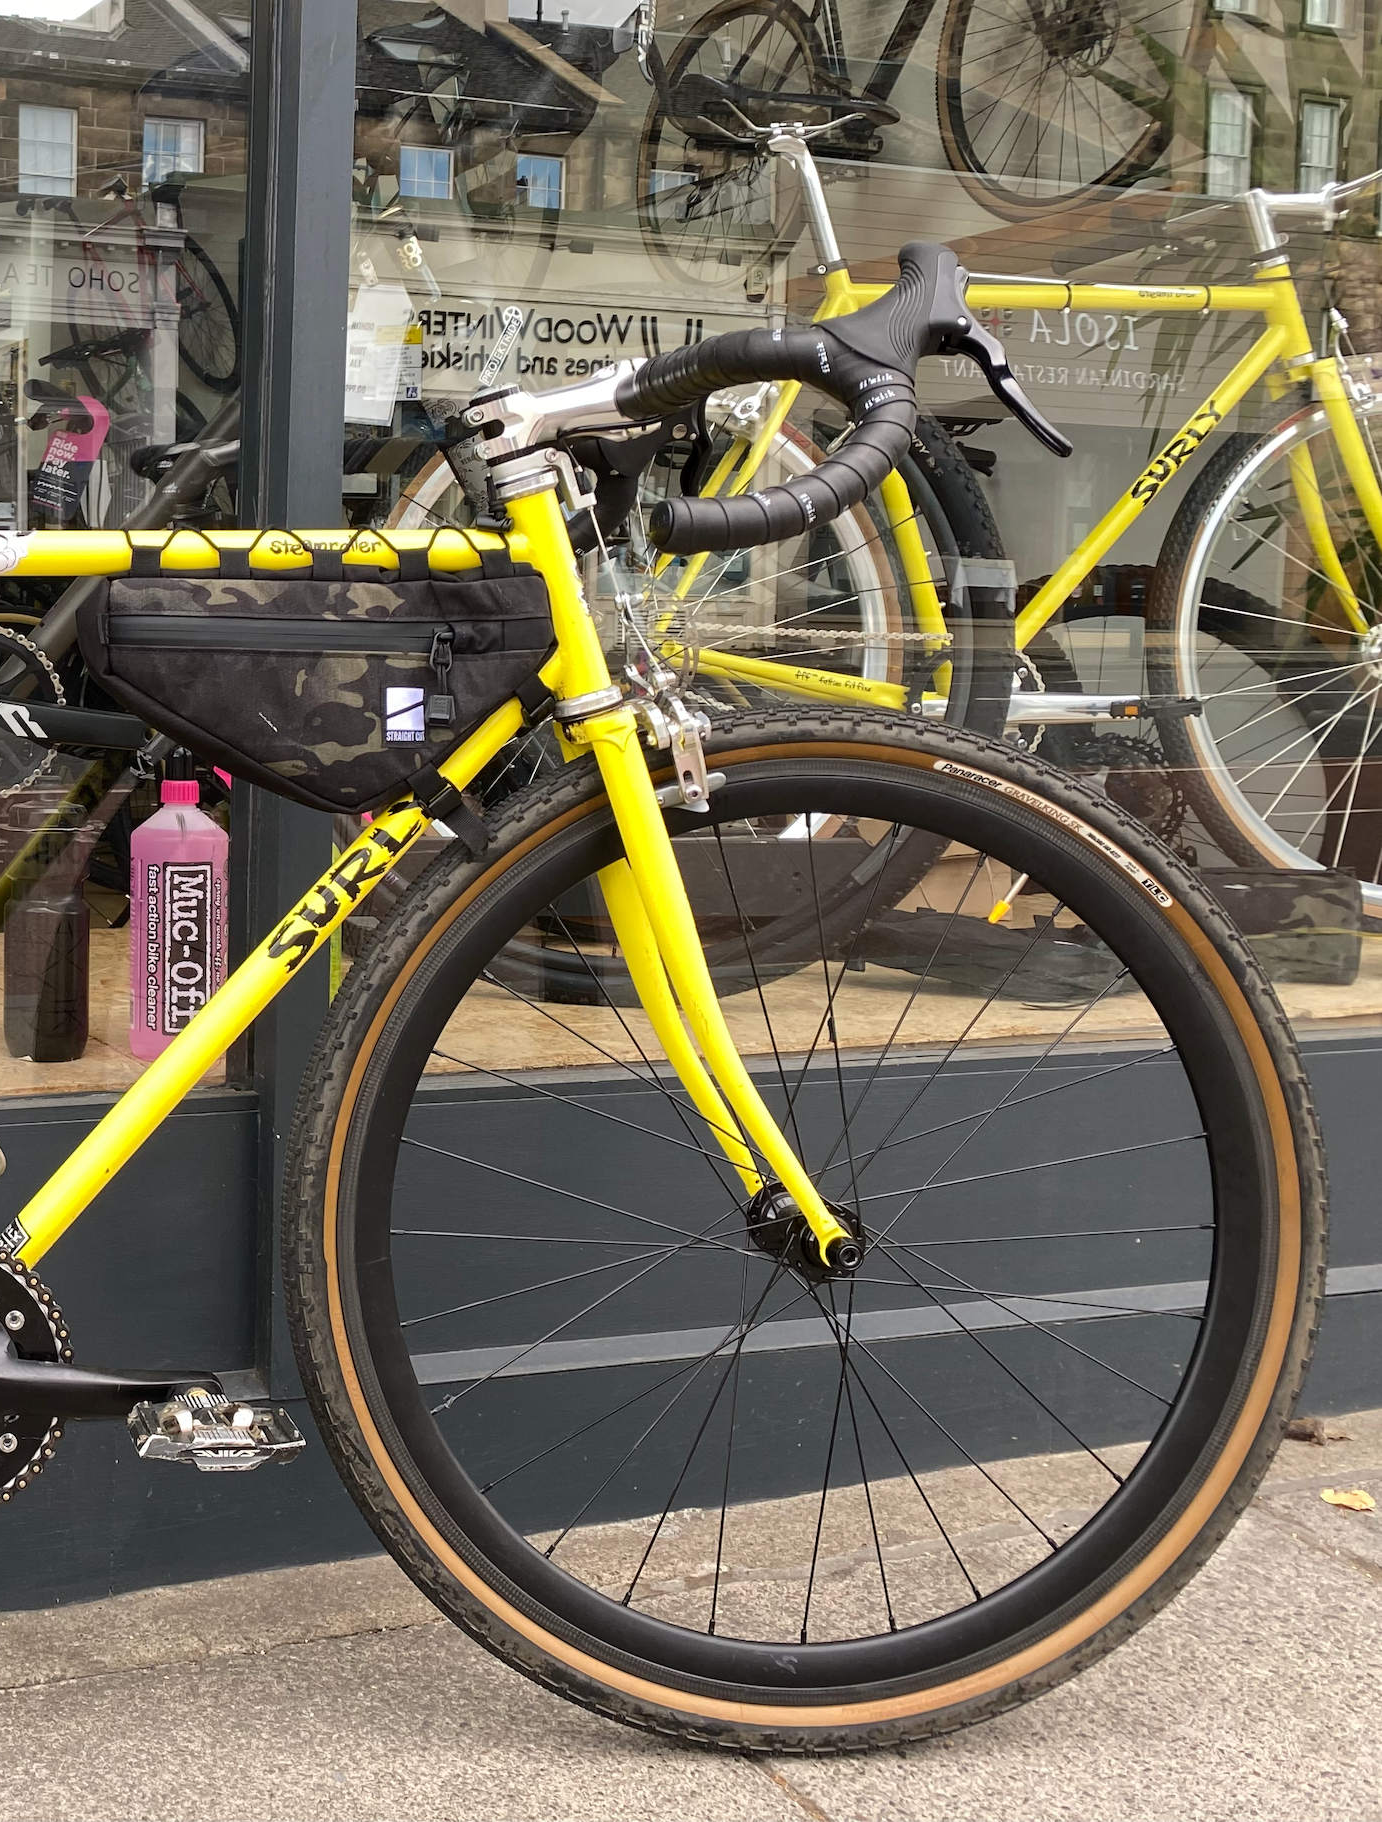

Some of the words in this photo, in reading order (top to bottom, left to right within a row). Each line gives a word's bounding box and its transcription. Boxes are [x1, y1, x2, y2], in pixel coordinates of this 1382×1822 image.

[45, 454, 67, 468] Pay
[52, 438, 78, 453] Ride
[1131, 400, 1222, 507] SURLY
[386, 731, 415, 741] STRAIGHT
[941, 763, 1003, 788] Panaracer
[1004, 786, 1070, 823] GRAVELKING
[1068, 819, 1084, 833] SK
[147, 864, 160, 897] fast
[147, 898, 160, 941] action
[147, 942, 160, 973] bike
[170, 873, 206, 1023] Muc-Off
[147, 974, 160, 1030] cleaner
